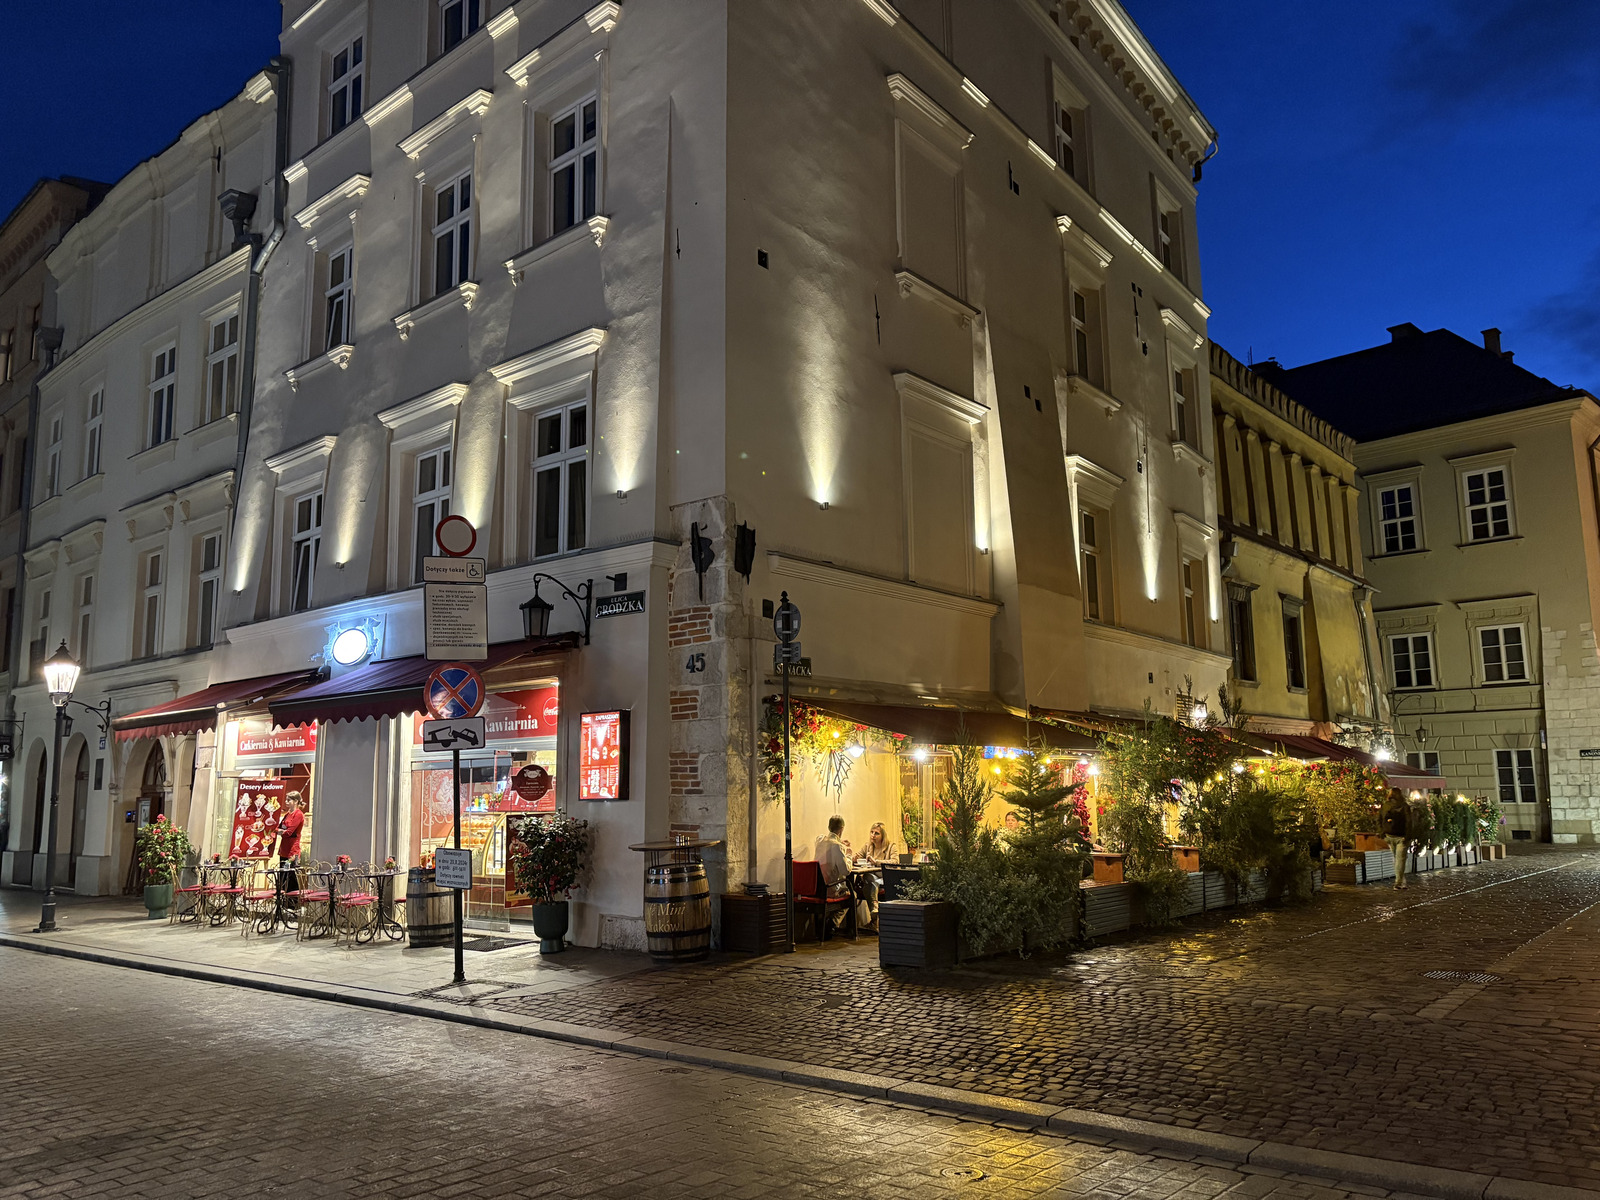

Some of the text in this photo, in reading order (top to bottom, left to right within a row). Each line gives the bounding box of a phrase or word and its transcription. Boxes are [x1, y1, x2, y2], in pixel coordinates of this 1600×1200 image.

[596, 600, 644, 616] GRODZKA
[686, 653, 705, 673] 45
[240, 736, 305, 751] Cukiernia & Kawiarnia
[658, 903, 686, 916] Mini
[650, 920, 680, 932] raków
